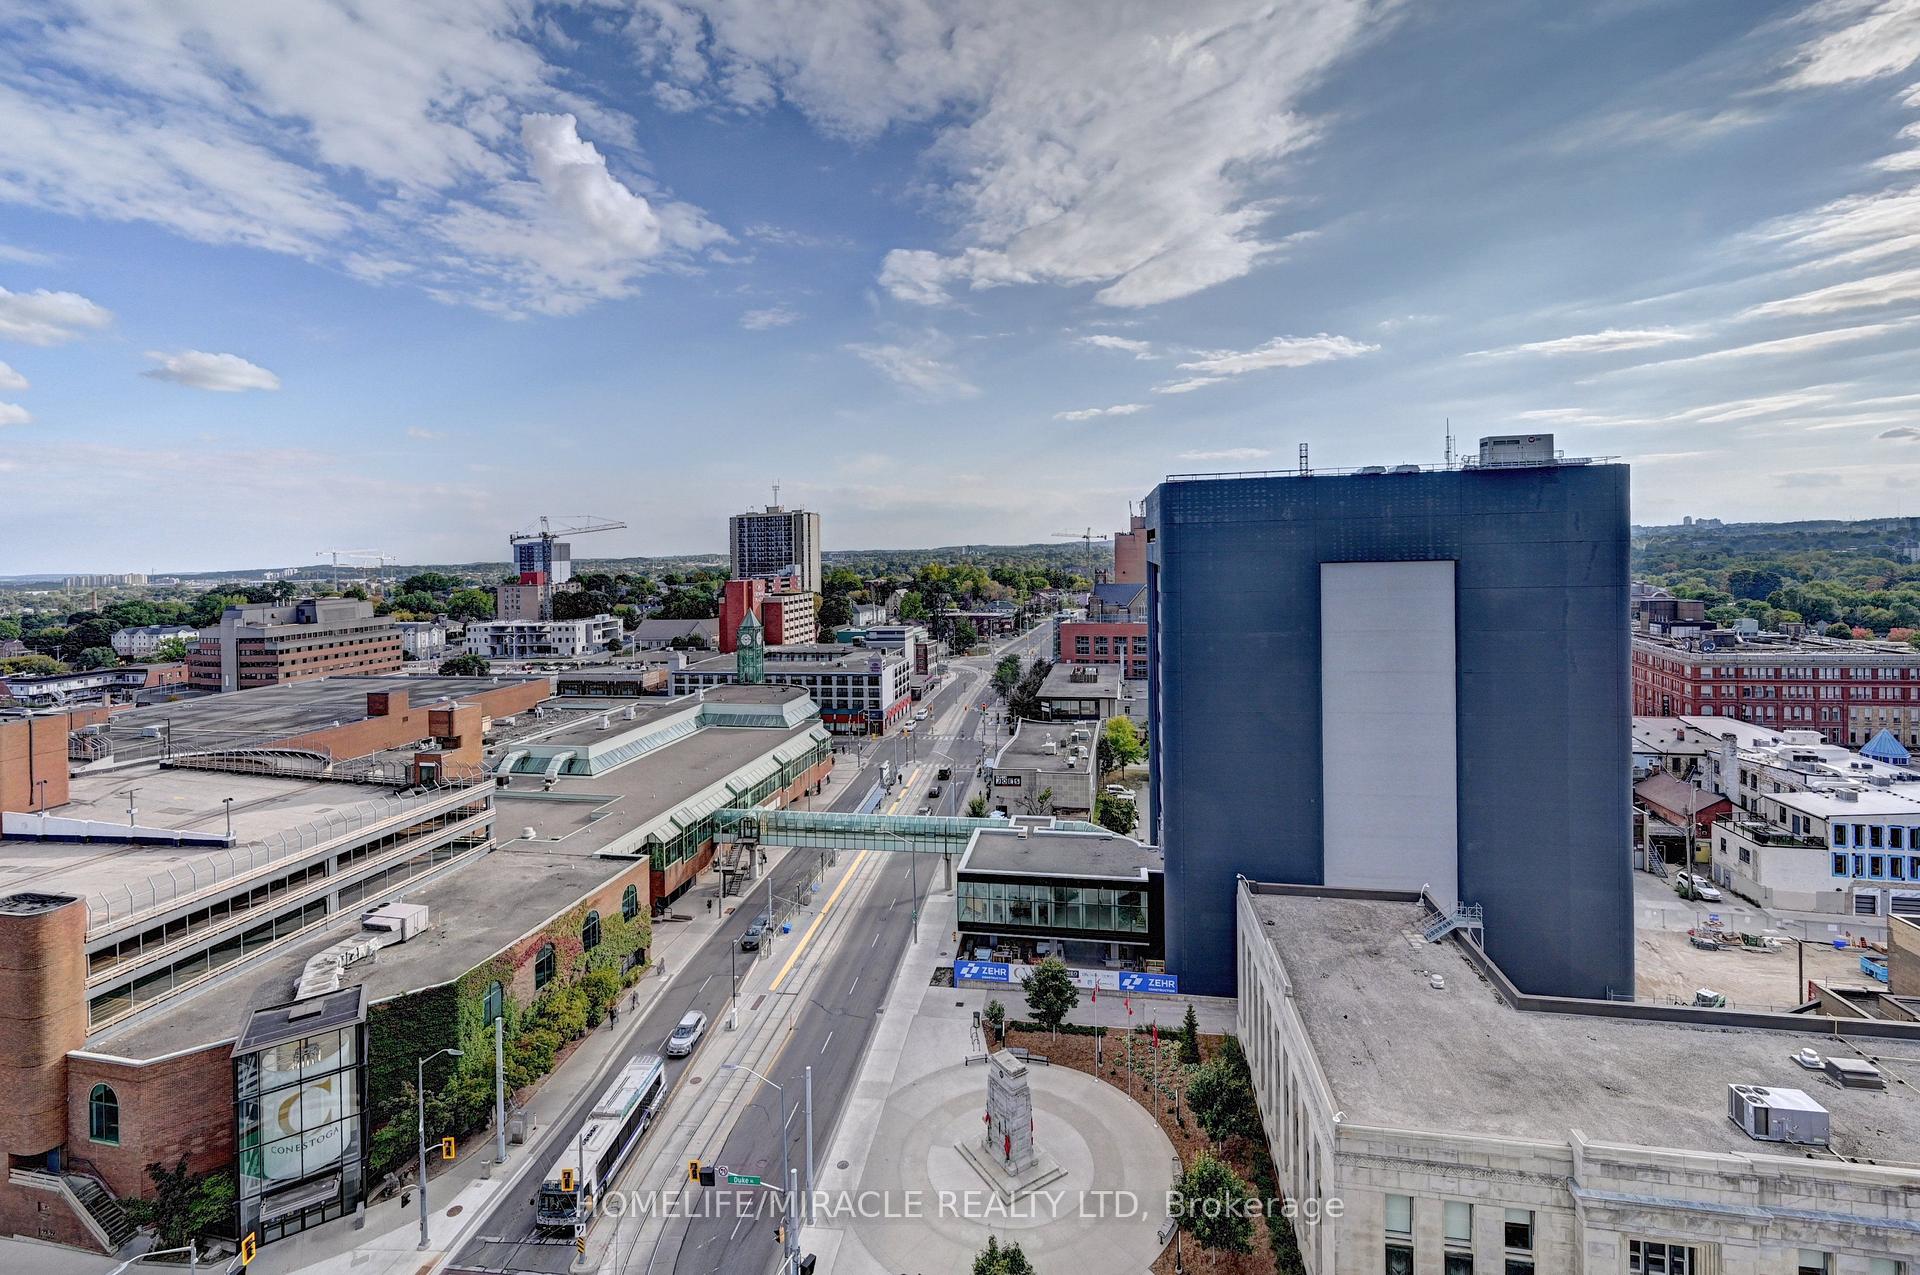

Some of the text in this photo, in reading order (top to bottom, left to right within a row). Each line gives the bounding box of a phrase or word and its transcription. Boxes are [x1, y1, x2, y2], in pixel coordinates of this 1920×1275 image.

[982, 966, 1007, 976] ZEHR
[1148, 978, 1175, 988] ZEHR
[270, 1126, 339, 1155] CONESTOGA
